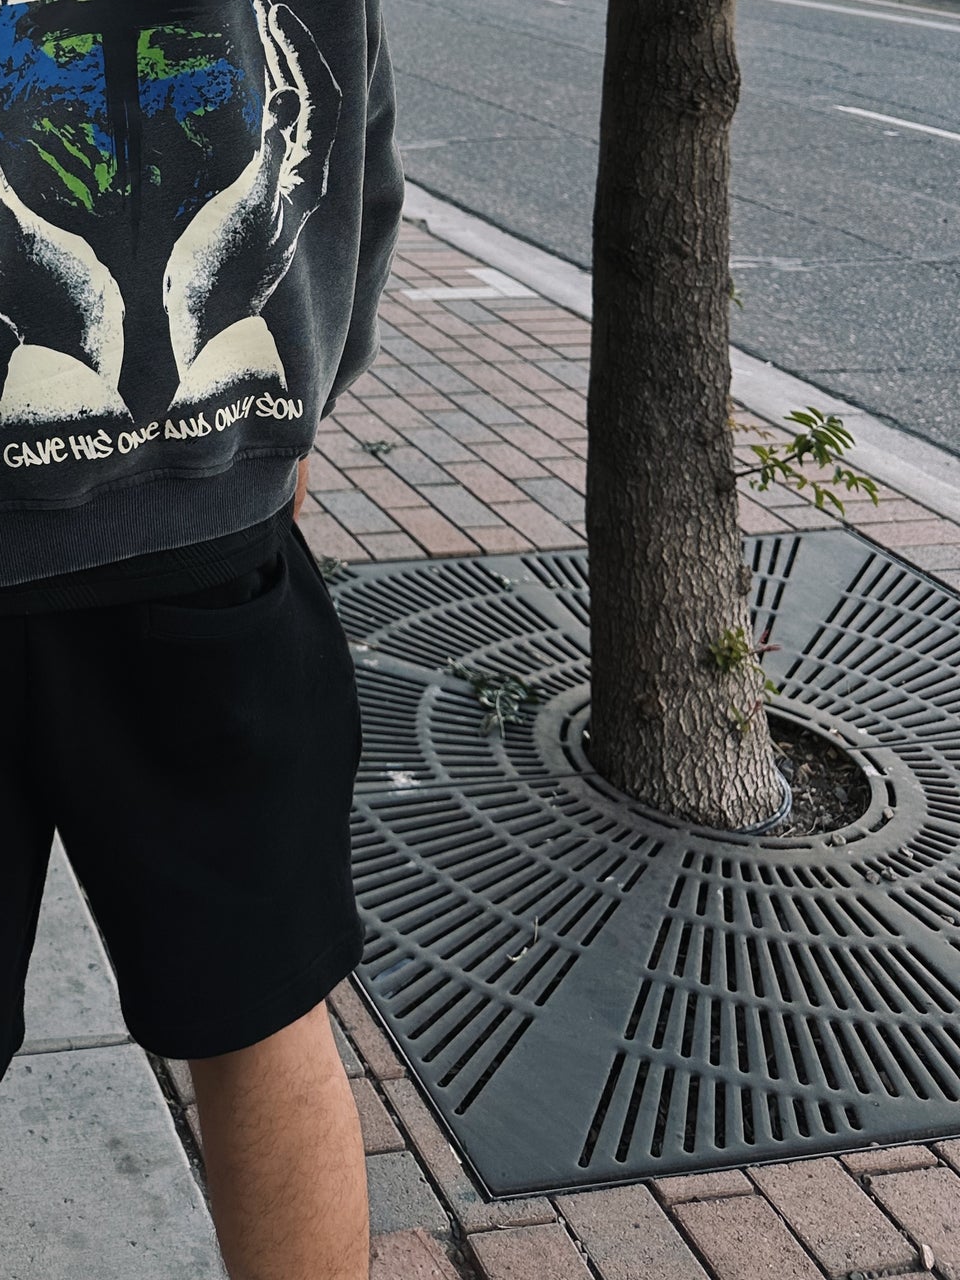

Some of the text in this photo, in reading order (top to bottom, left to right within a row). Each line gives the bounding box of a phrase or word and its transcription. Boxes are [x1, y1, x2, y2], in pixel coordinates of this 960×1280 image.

[68, 429, 114, 460] HIS
[164, 412, 212, 440] AND
[215, 395, 255, 432] ONLY
[256, 392, 303, 421] SON
